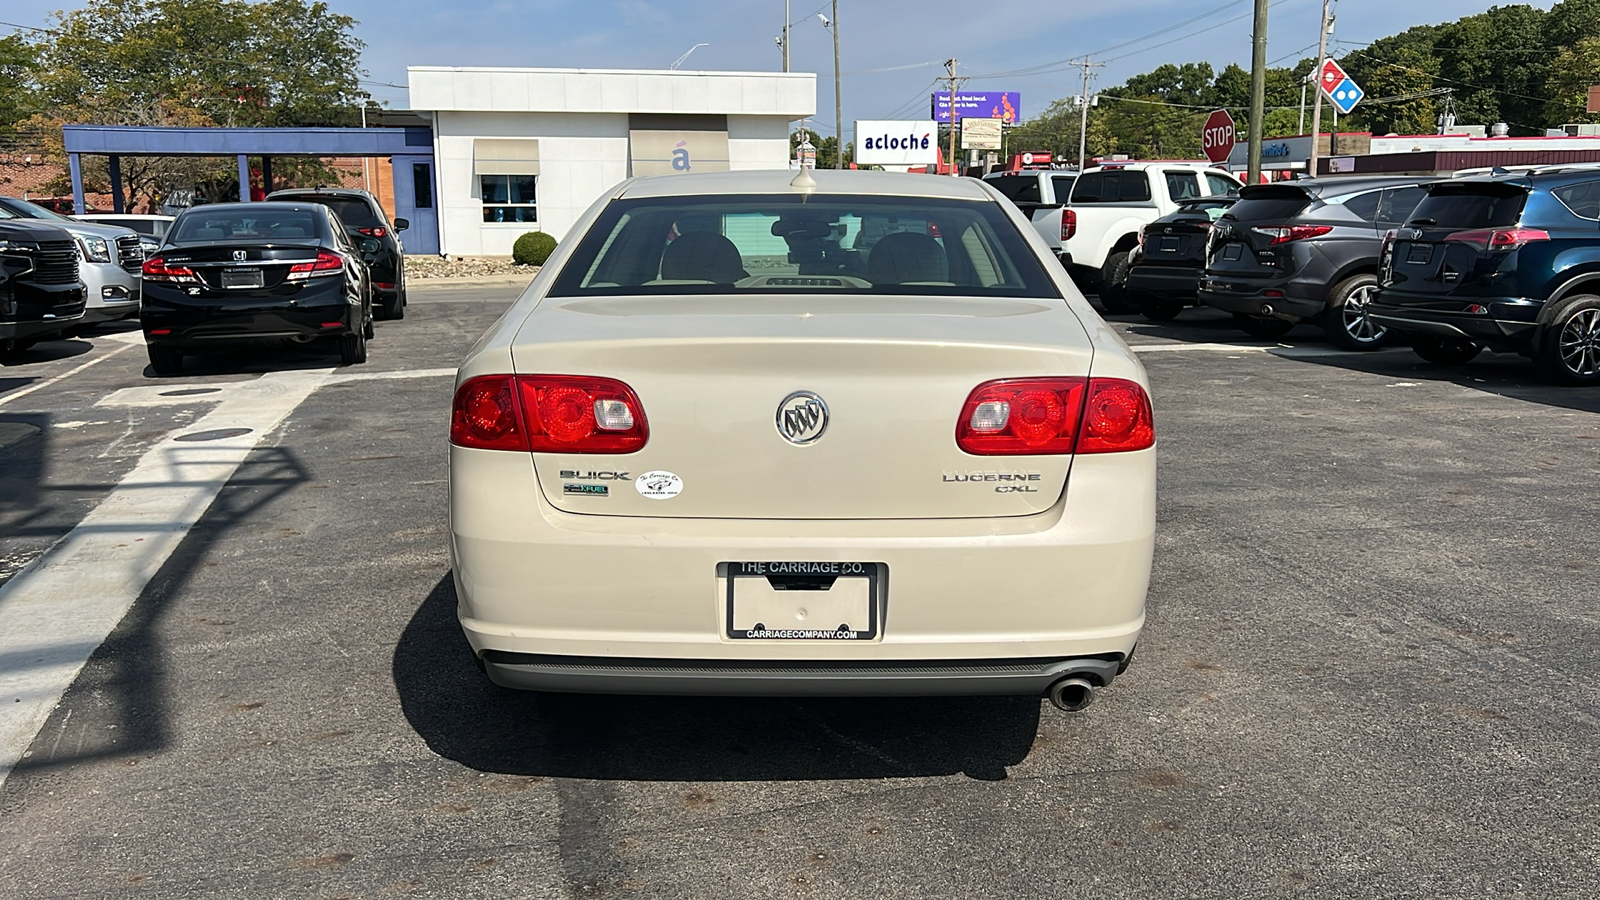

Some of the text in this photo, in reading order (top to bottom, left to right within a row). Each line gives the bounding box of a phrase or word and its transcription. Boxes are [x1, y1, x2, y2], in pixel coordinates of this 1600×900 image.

[865, 133, 930, 150] acloché
[1205, 126, 1232, 148] STOP
[672, 140, 691, 172] á
[560, 470, 632, 481] BUICK
[943, 474, 1041, 482] LUCERNE
[995, 485, 1038, 493] CXL
[740, 562, 865, 574] THE CARRIAGE CO.
[747, 630, 857, 639] CARRIAGECOMPANY.COM
